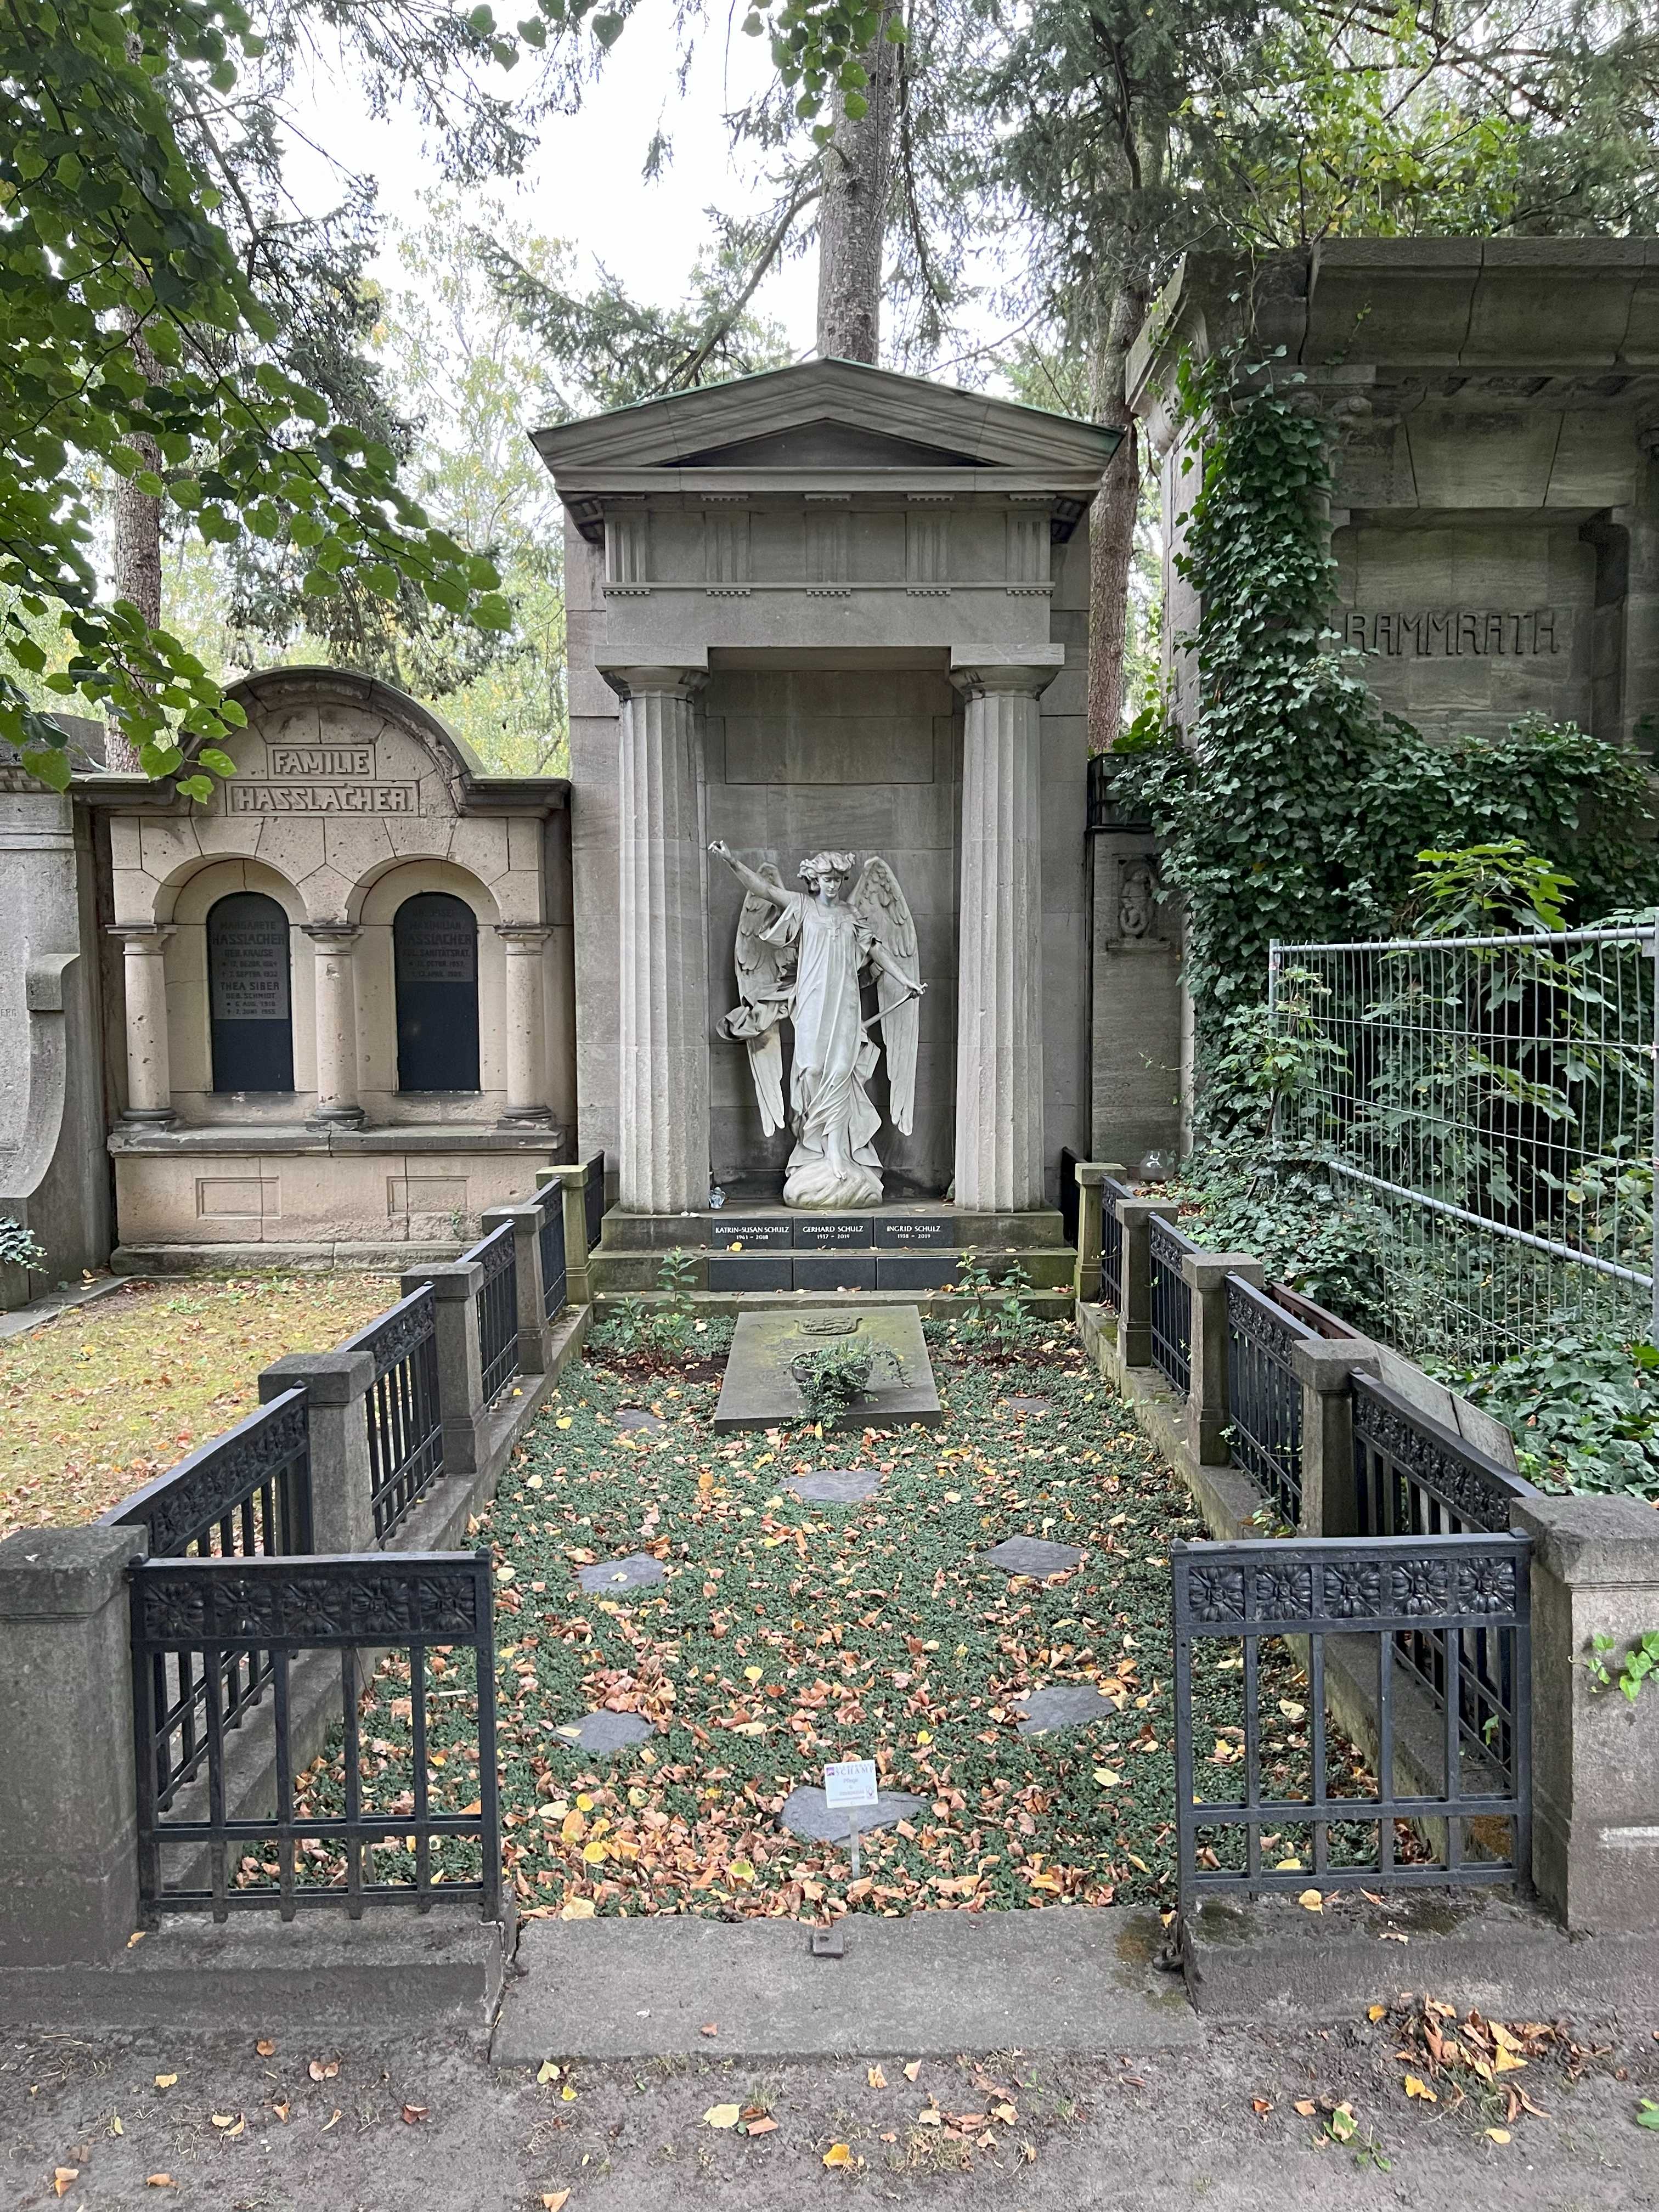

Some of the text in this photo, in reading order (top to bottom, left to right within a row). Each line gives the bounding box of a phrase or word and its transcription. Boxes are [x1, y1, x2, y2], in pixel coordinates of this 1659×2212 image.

[1345, 611, 1558, 655] RAMMRATH
[275, 752, 370, 775] FAMILIE
[239, 788, 407, 811] HASSLACHER
[221, 921, 276, 929] MARGARETE
[213, 933, 285, 945] HASSLACHER
[221, 982, 279, 990] THEA SIBER
[836, 1766, 874, 1776] SCHAMP
